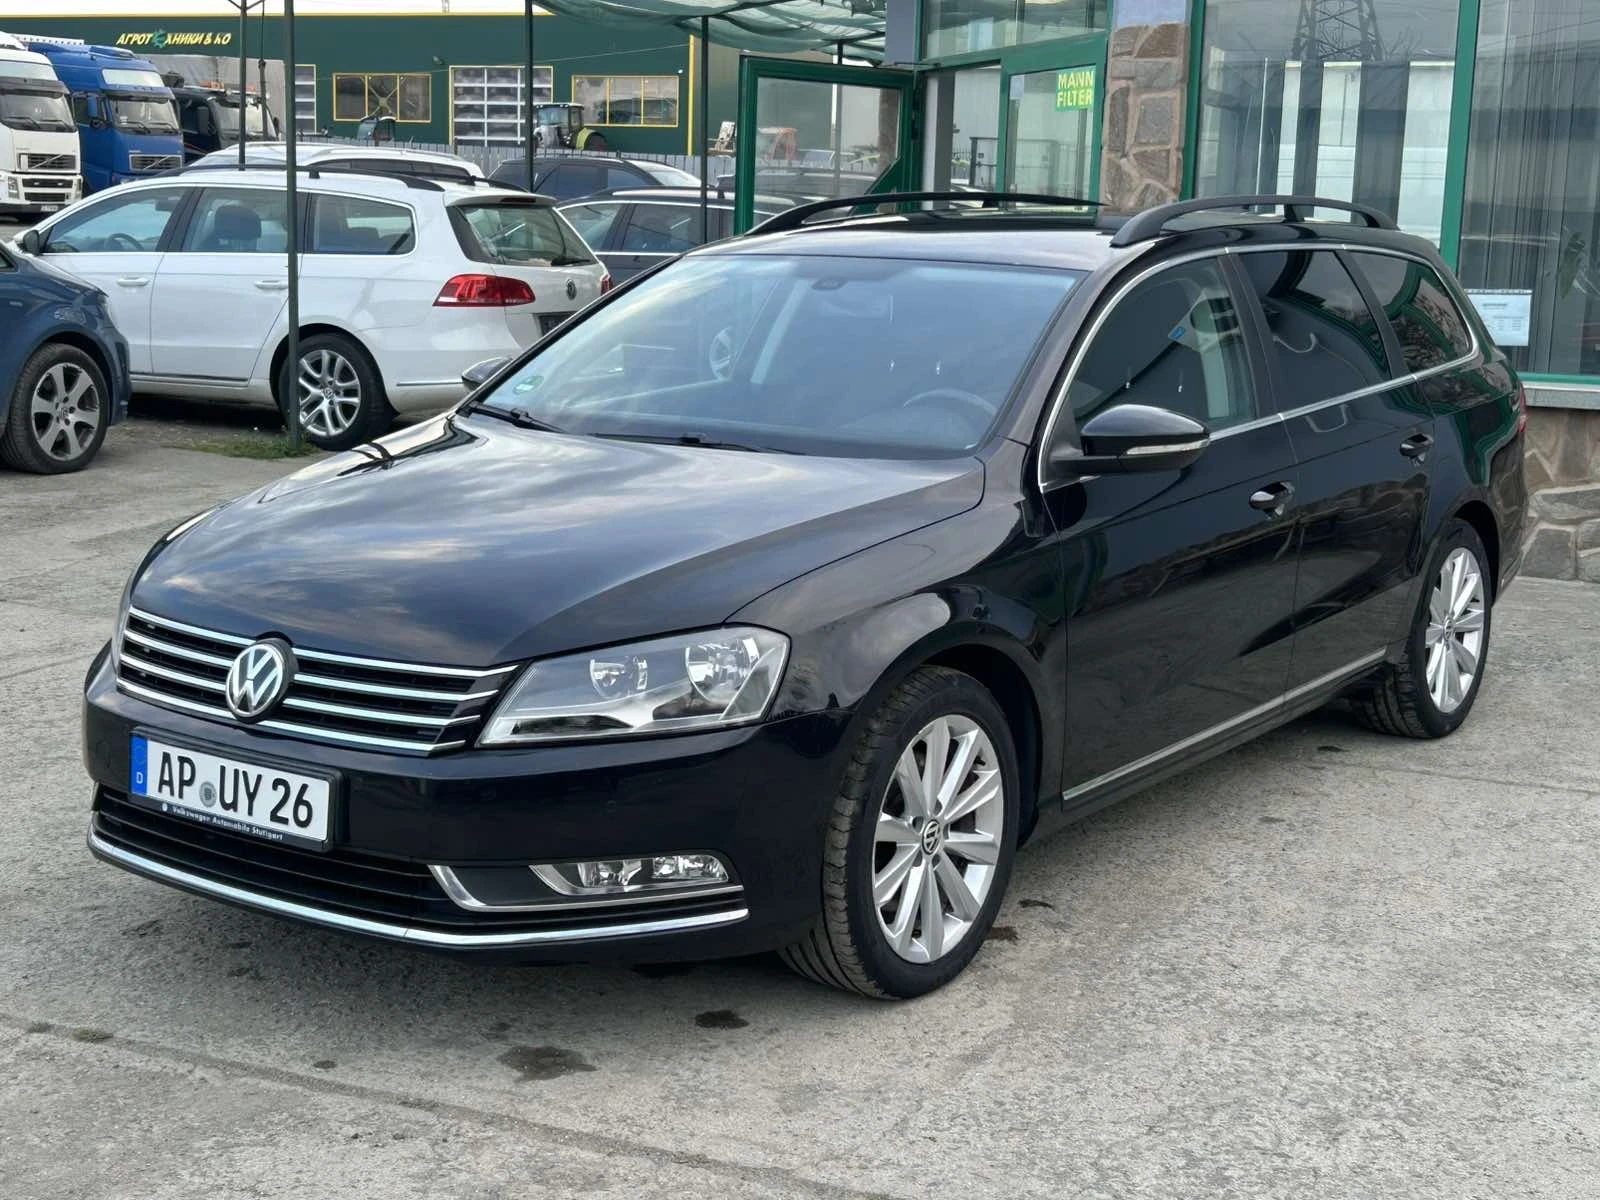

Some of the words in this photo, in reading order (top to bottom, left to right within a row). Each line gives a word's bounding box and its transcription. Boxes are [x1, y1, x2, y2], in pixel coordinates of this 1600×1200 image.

[1058, 70, 1094, 89] MANN
[1056, 89, 1093, 108] FILTER
[135, 772, 144, 784] D
[158, 751, 197, 800] AP
[219, 765, 262, 817] UY
[269, 777, 313, 829] 26
[172, 806, 211, 823] Volkswagen
[211, 816, 250, 833] Automobile
[251, 826, 283, 841] Stuttgart
